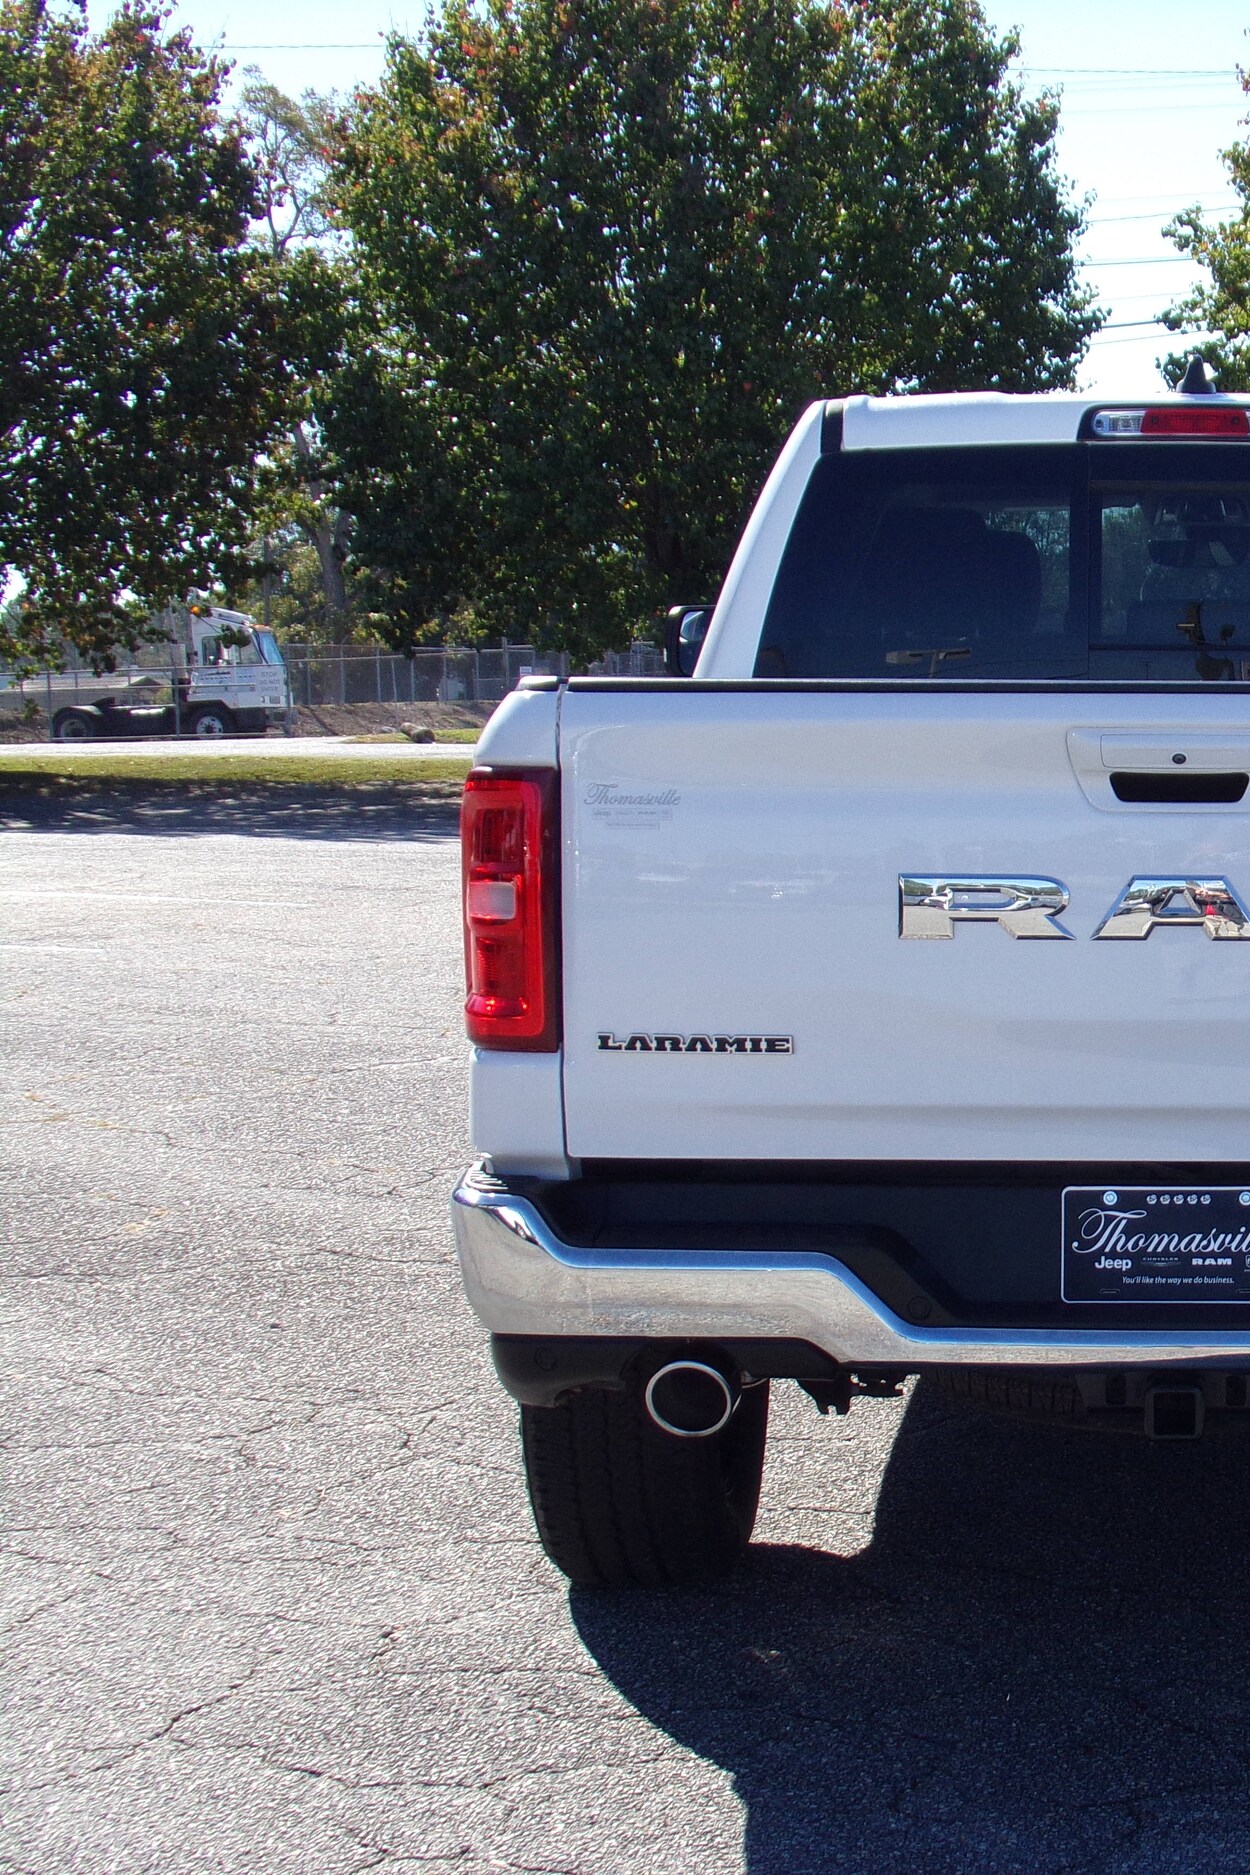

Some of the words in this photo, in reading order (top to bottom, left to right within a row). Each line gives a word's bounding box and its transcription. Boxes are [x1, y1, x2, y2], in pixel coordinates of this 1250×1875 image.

[584, 782, 681, 805] Thomasville
[597, 1032, 795, 1055] LARAMIE
[1095, 1255, 1132, 1271] Jeep
[1191, 1257, 1233, 1266] RAM
[1141, 1275, 1154, 1284] like
[1155, 1275, 1167, 1284] the
[1167, 1277, 1182, 1286] way
[1193, 1275, 1203, 1284] do
[1203, 1275, 1235, 1284] business.
